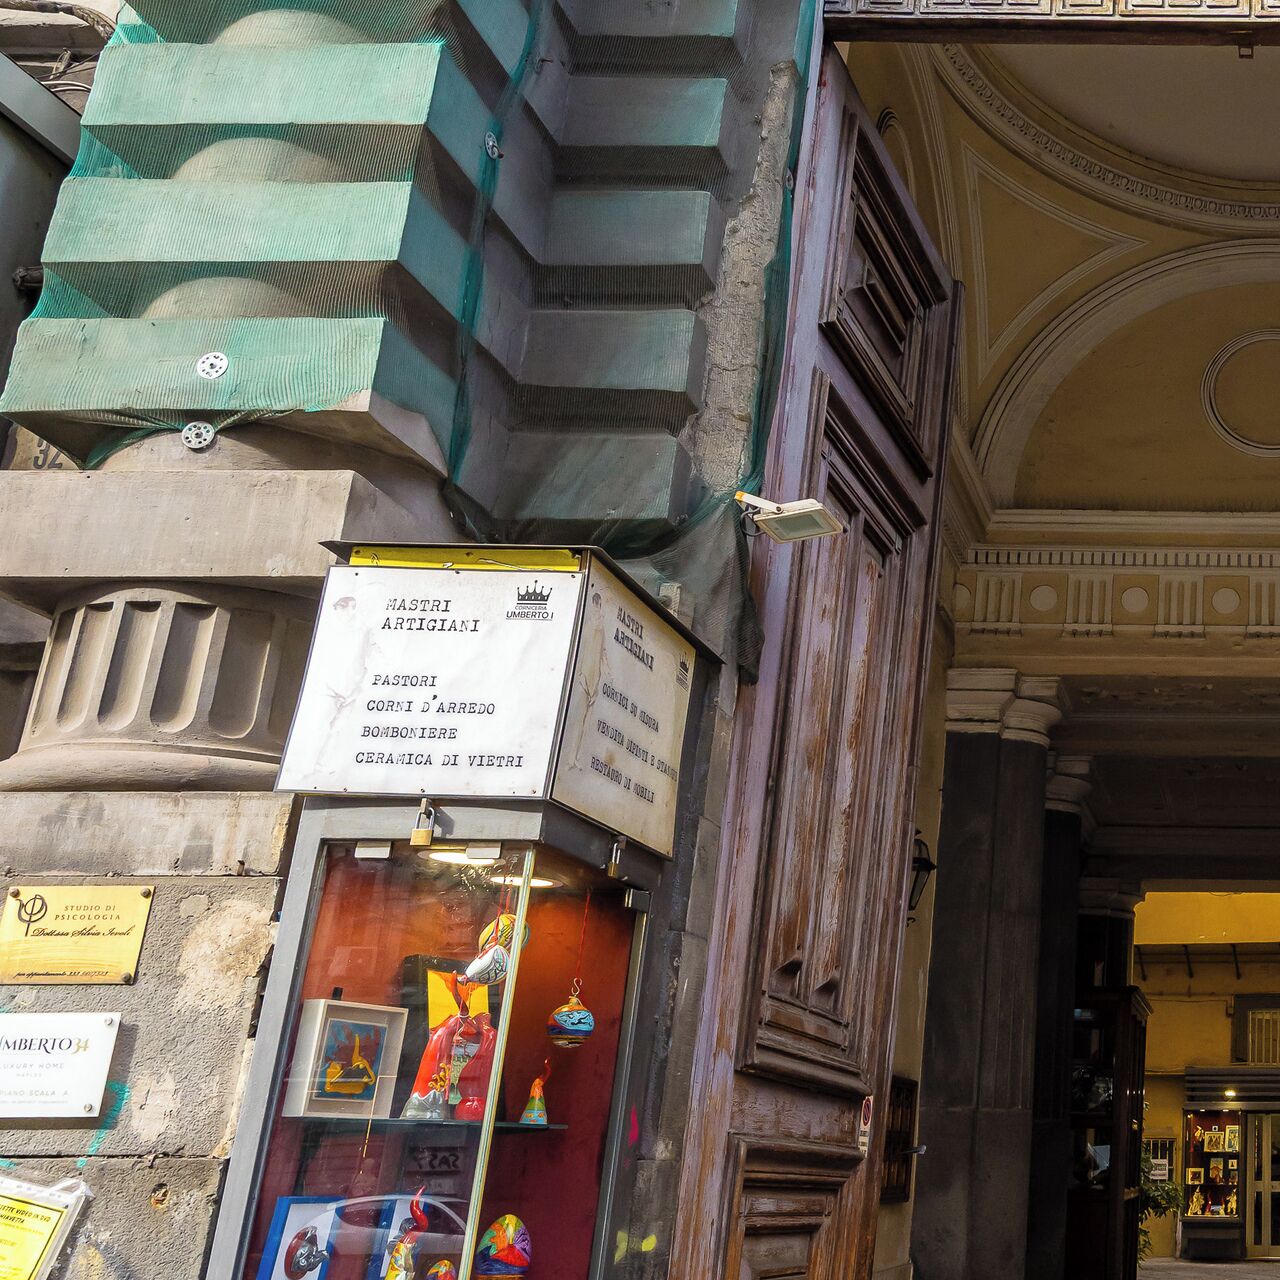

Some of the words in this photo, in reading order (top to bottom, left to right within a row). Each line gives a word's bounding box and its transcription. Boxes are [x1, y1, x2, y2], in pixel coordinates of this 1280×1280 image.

[385, 598, 452, 613] MASTRI
[506, 610, 549, 619] UMBERTO
[550, 611, 554, 619] I
[381, 617, 480, 633] ARTIGIANI
[617, 606, 643, 640] MASTRI
[614, 627, 654, 671] ARTIGIANI
[372, 674, 438, 688] PASTORI
[366, 699, 413, 713] CORNI
[421, 694, 496, 715] D'ARREDO
[602, 683, 629, 713] CORNICI
[361, 725, 458, 740] BOMBONIERE
[597, 719, 625, 746] VENDITA
[355, 752, 433, 766] CERAMICA
[442, 754, 460, 767] DI
[468, 754, 524, 768] VIETRI
[590, 756, 622, 785] RESTAURO
[71, 924, 101, 938] Silvia
